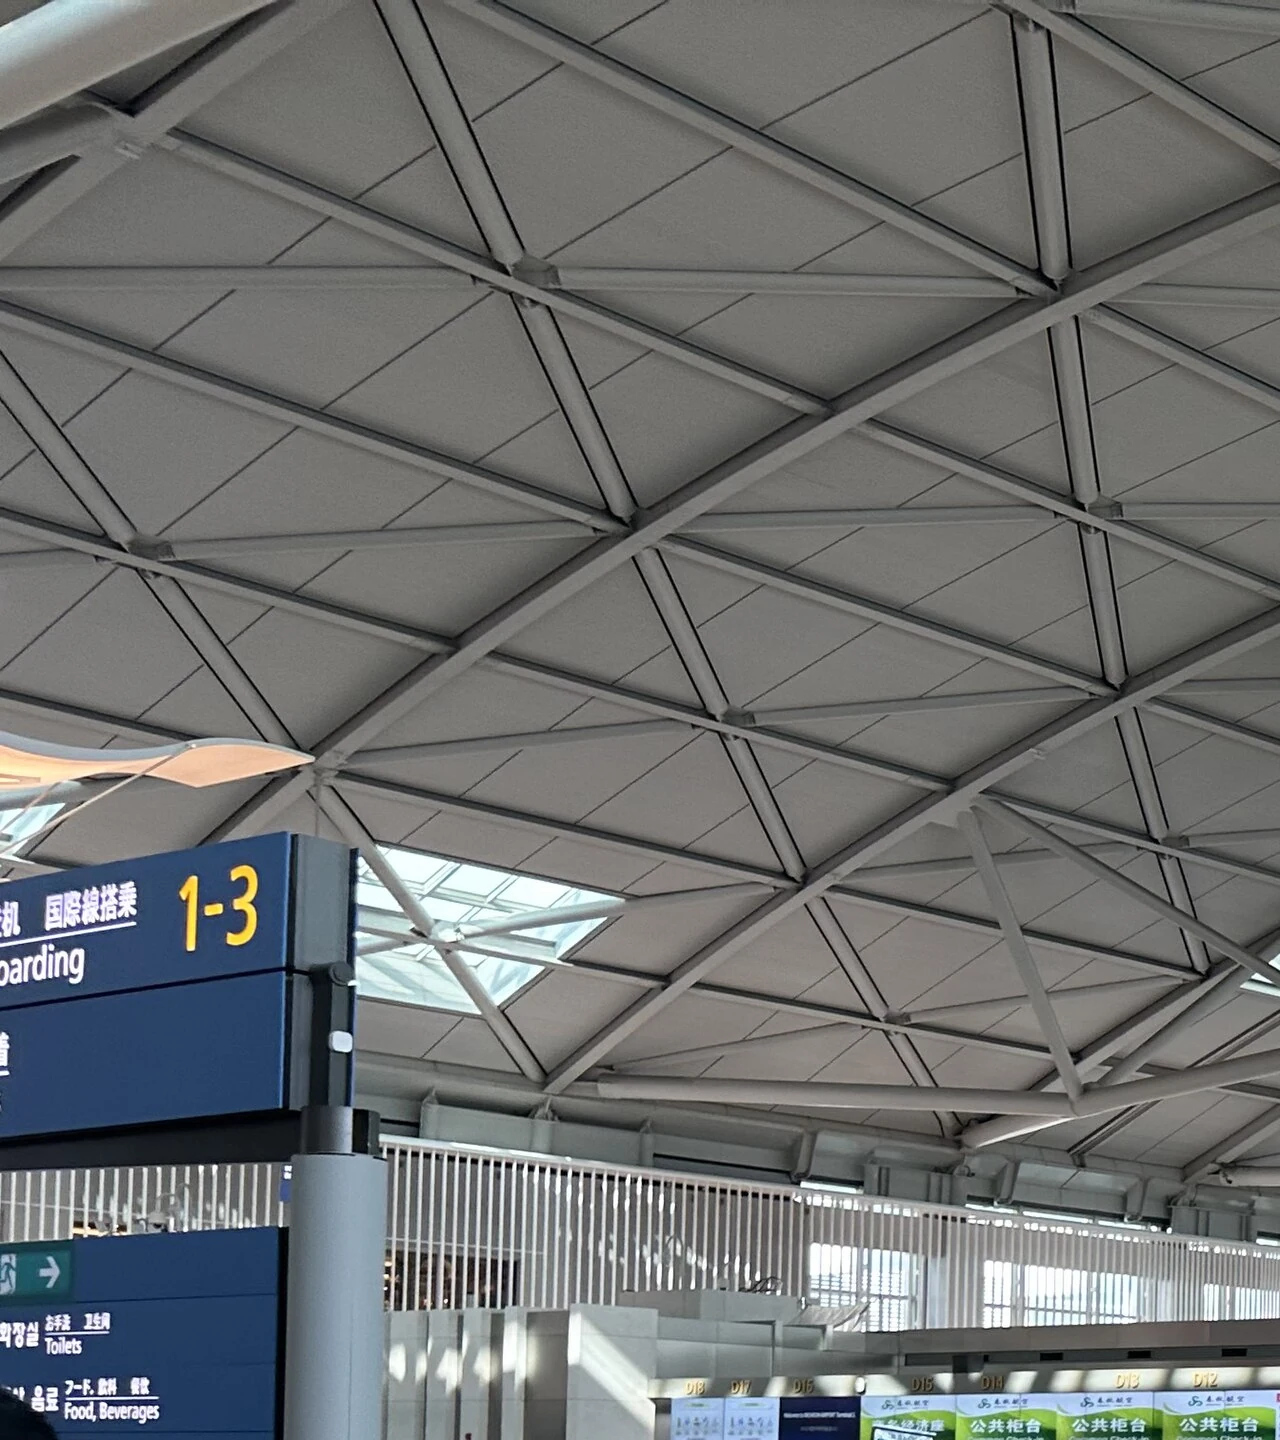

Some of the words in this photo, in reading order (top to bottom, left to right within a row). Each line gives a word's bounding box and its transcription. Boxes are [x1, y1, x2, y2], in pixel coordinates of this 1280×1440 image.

[179, 864, 259, 952] 1-3
[0, 943, 85, 987] oarding
[0, 1321, 39, 1348] 화장실
[45, 1337, 82, 1355] Toilets
[1193, 1373, 1218, 1388] D12
[31, 1385, 59, 1412] 음료
[64, 1401, 96, 1422] Food,
[99, 1402, 160, 1424] Beverages
[970, 1419, 1042, 1434] 公共柜台
[1072, 1417, 1147, 1433] 公共柜台
[1179, 1416, 1260, 1433] 公共柜台
